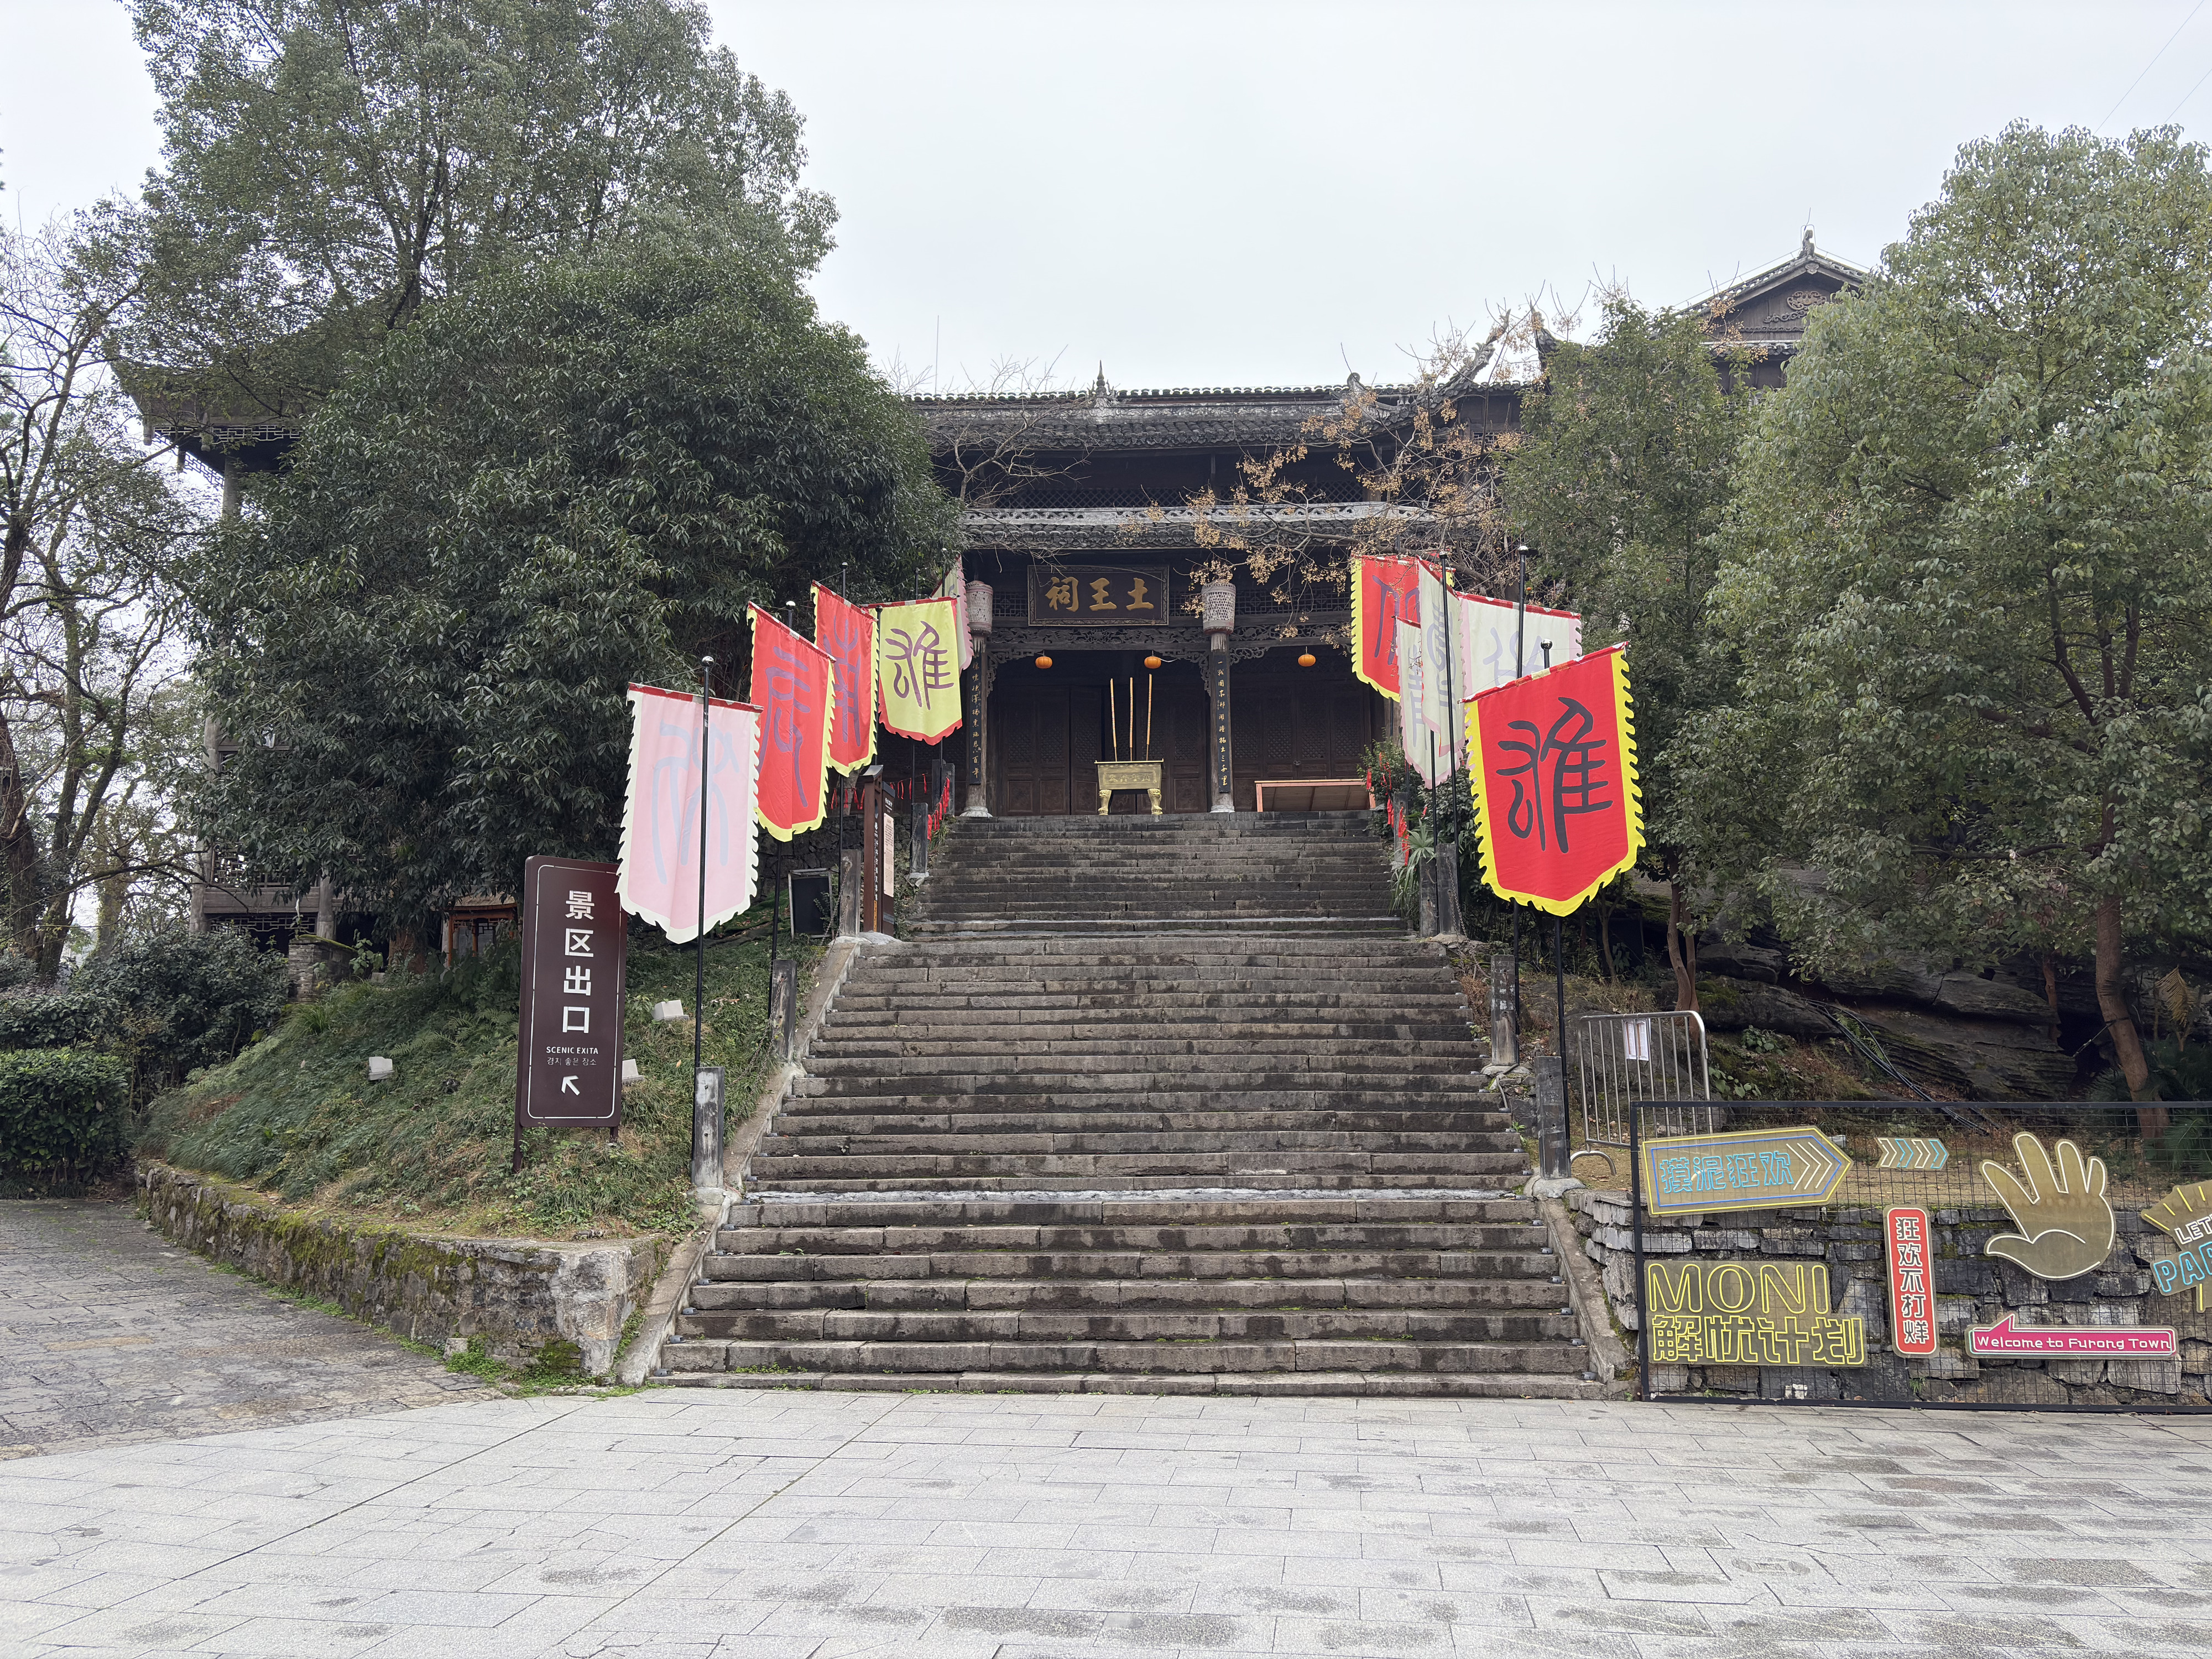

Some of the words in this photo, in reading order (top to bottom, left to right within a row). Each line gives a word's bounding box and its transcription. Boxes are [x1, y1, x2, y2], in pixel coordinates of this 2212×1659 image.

[1045, 577, 1154, 612] 土王祠
[562, 890, 595, 1034] 景区出口
[547, 1057, 561, 1066] 경치
[582, 1057, 597, 1066] 장소
[1660, 1150, 1794, 1193] 摸泥狂欢
[1648, 1264, 1829, 1314] MONI
[1895, 1217, 1929, 1344] 狂欢不打烊
[1652, 1315, 1864, 1364] 解忧计划
[1976, 1336, 2043, 1348] Welcome
[2046, 1337, 2063, 1348] to
[2068, 1338, 2125, 1350] Furong
[2128, 1338, 2172, 1349] Town
